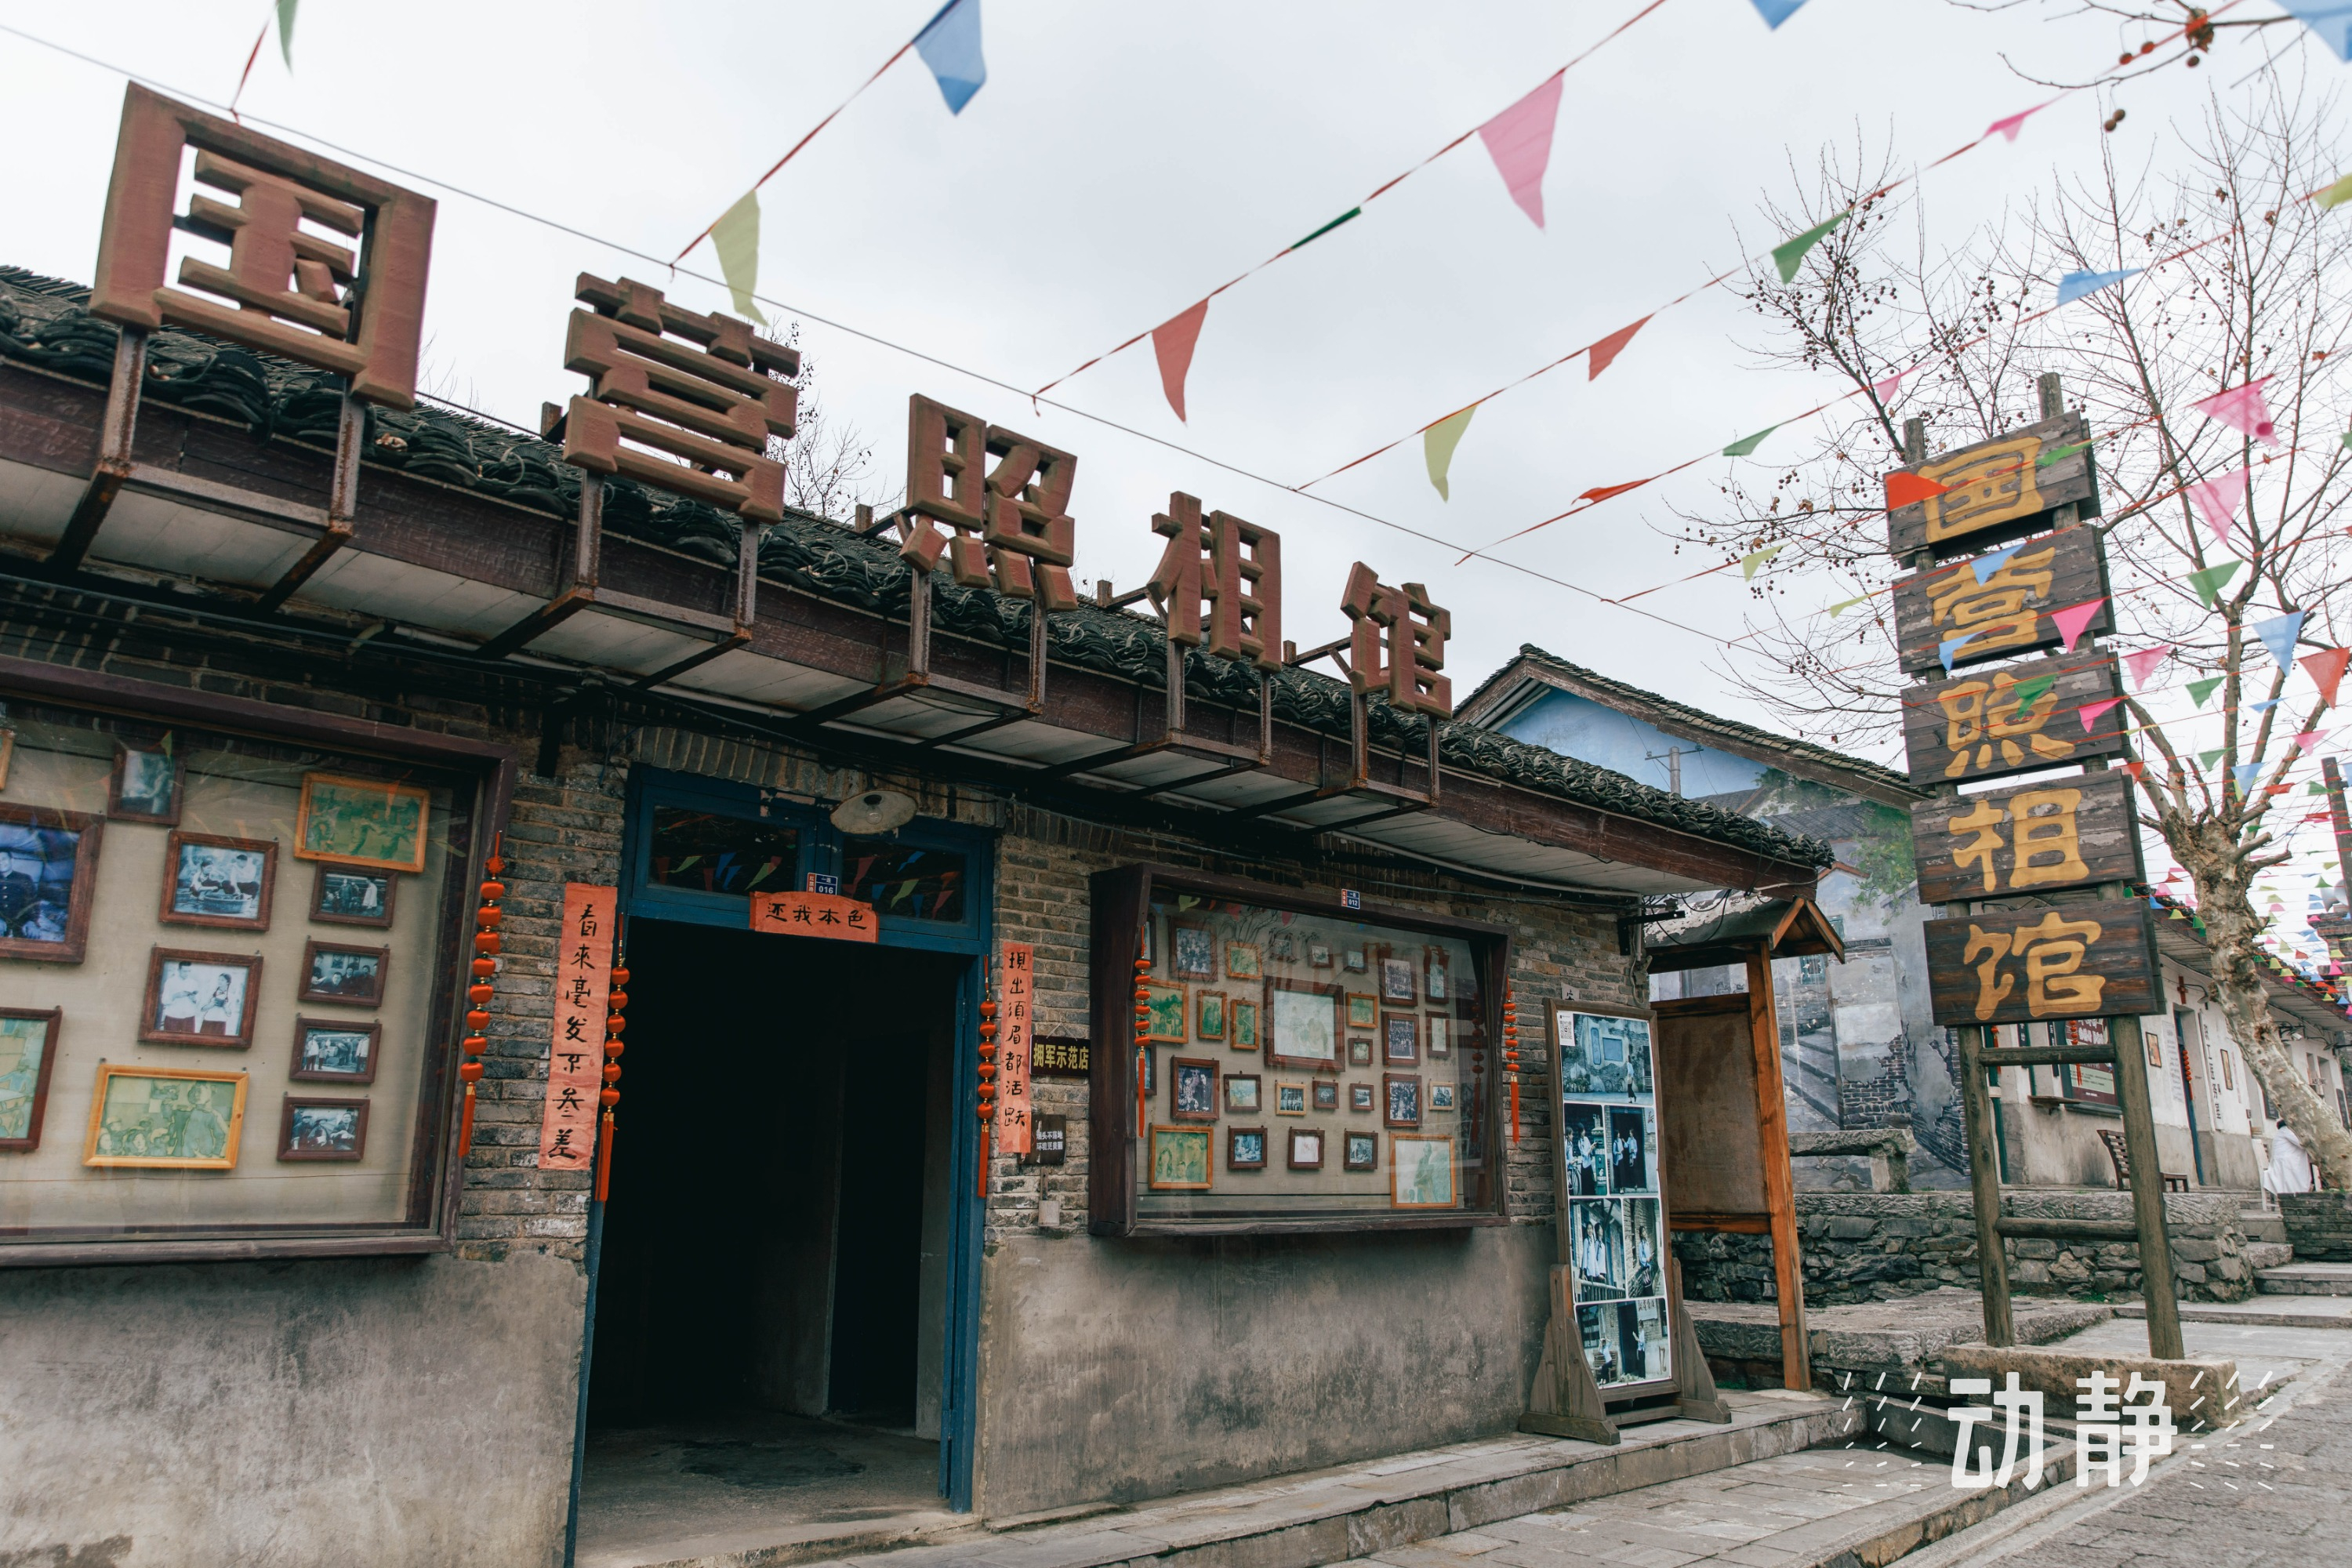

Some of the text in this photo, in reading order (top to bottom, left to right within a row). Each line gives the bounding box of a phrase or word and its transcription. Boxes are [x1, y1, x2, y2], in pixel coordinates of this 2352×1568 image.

[90, 80, 1452, 721] 国营照相馆
[818, 885, 834, 894] 016
[765, 902, 867, 930] 还我本色
[1033, 1043, 1090, 1070] 拥军示范店
